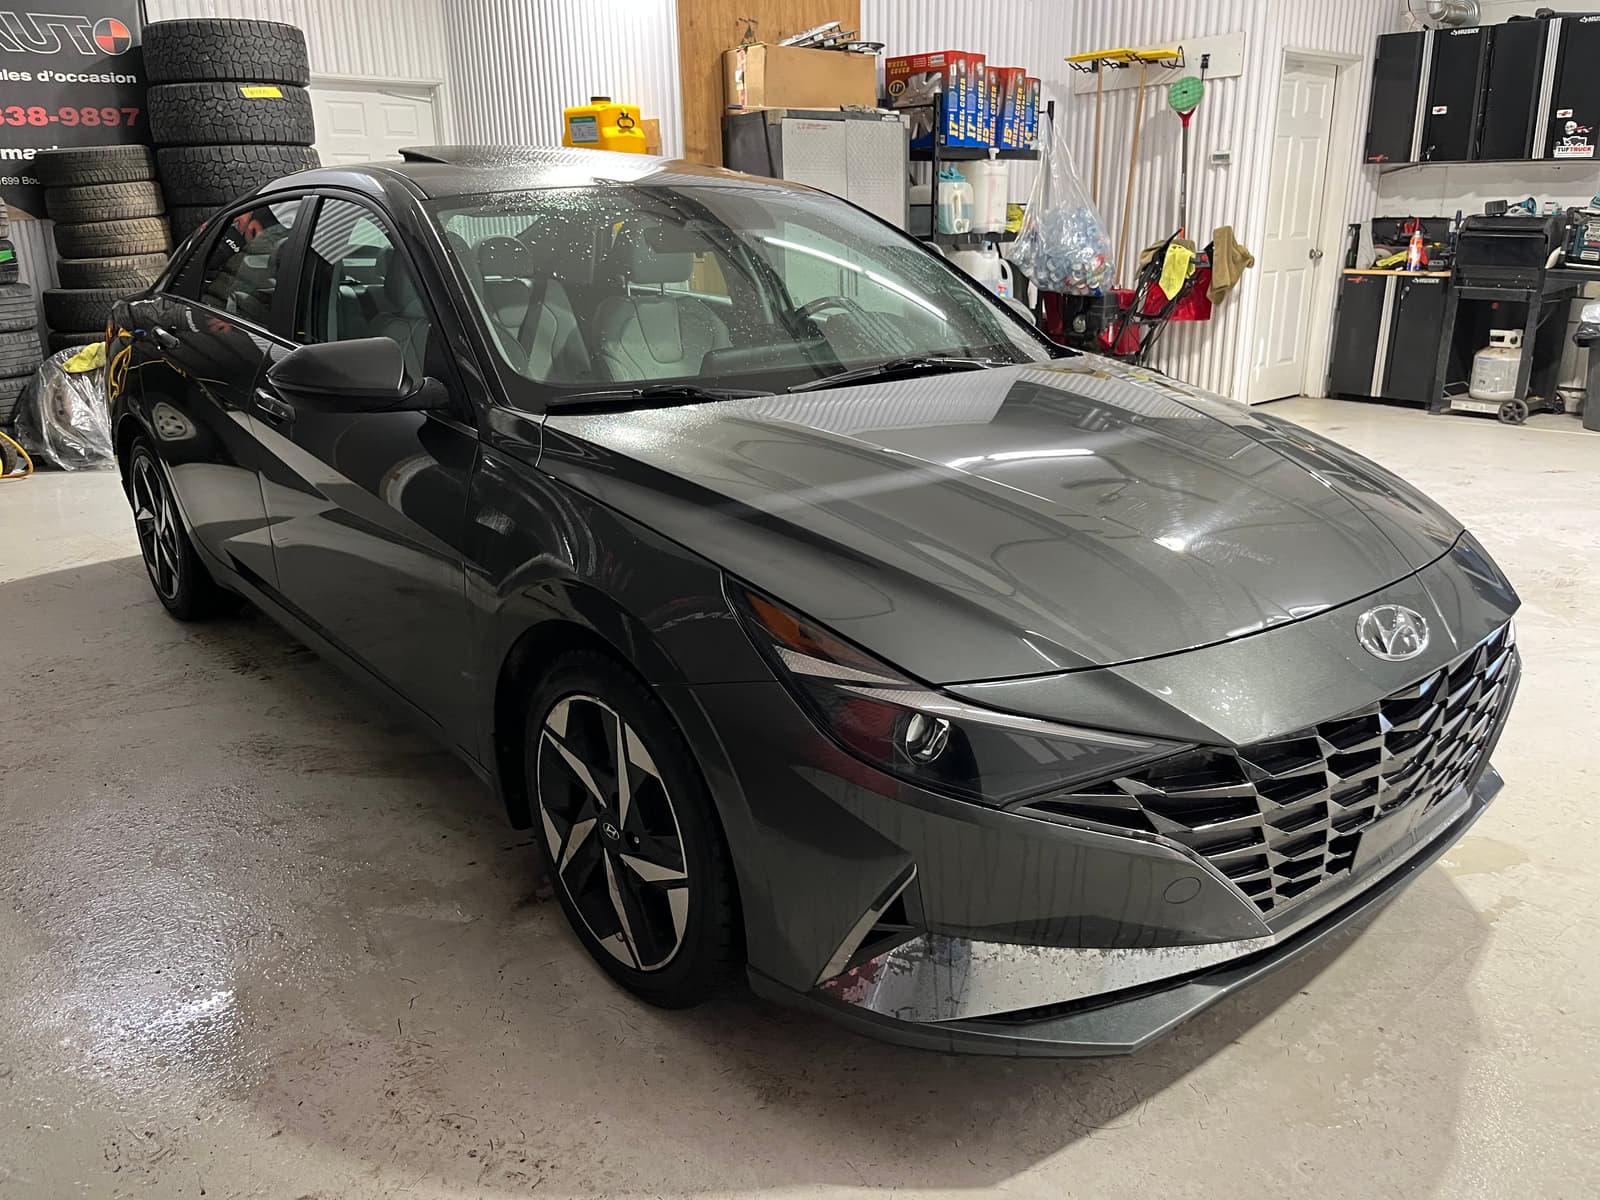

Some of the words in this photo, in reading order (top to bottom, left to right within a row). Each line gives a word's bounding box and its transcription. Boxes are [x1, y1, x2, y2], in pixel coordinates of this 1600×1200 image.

[37, 70, 137, 84] d'occasion
[1015, 87, 1023, 117] COVER
[949, 114, 958, 137] 17"
[966, 115, 976, 139] 17"
[976, 112, 984, 142] WHEEL
